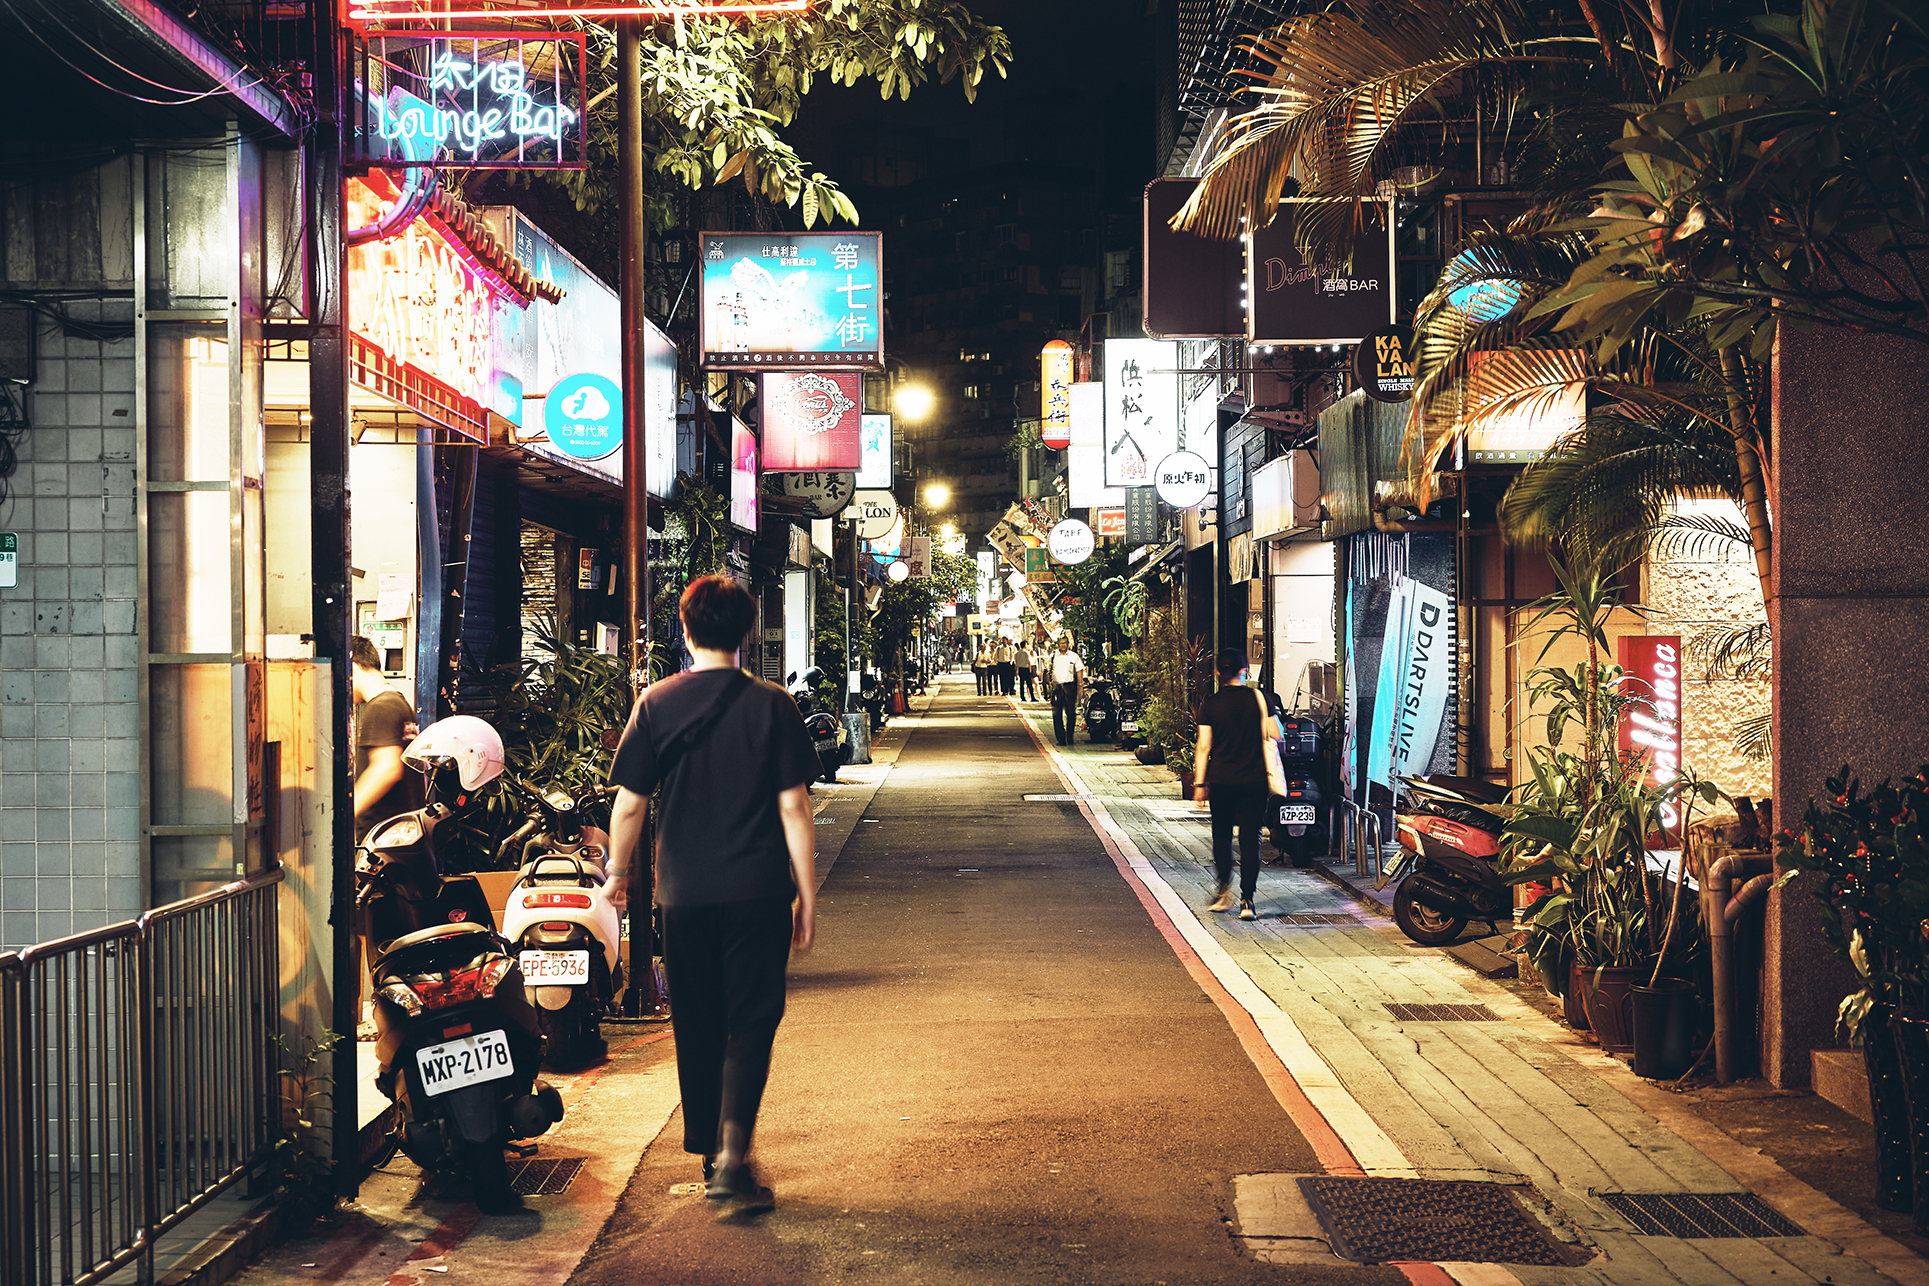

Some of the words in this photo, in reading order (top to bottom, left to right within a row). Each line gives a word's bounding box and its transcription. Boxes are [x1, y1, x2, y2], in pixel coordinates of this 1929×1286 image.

[378, 94, 505, 151] Lounge
[510, 92, 575, 140] Bar
[831, 243, 872, 348] 第七街
[1375, 335, 1402, 350] KA
[1376, 349, 1403, 364] VA
[1376, 362, 1415, 377] LAN
[1378, 382, 1415, 392] WHISKY
[561, 423, 609, 438] 台灣代駕
[866, 507, 891, 518] LON
[1030, 550, 1048, 561] よし
[1392, 630, 1434, 763] DARTSLIVE
